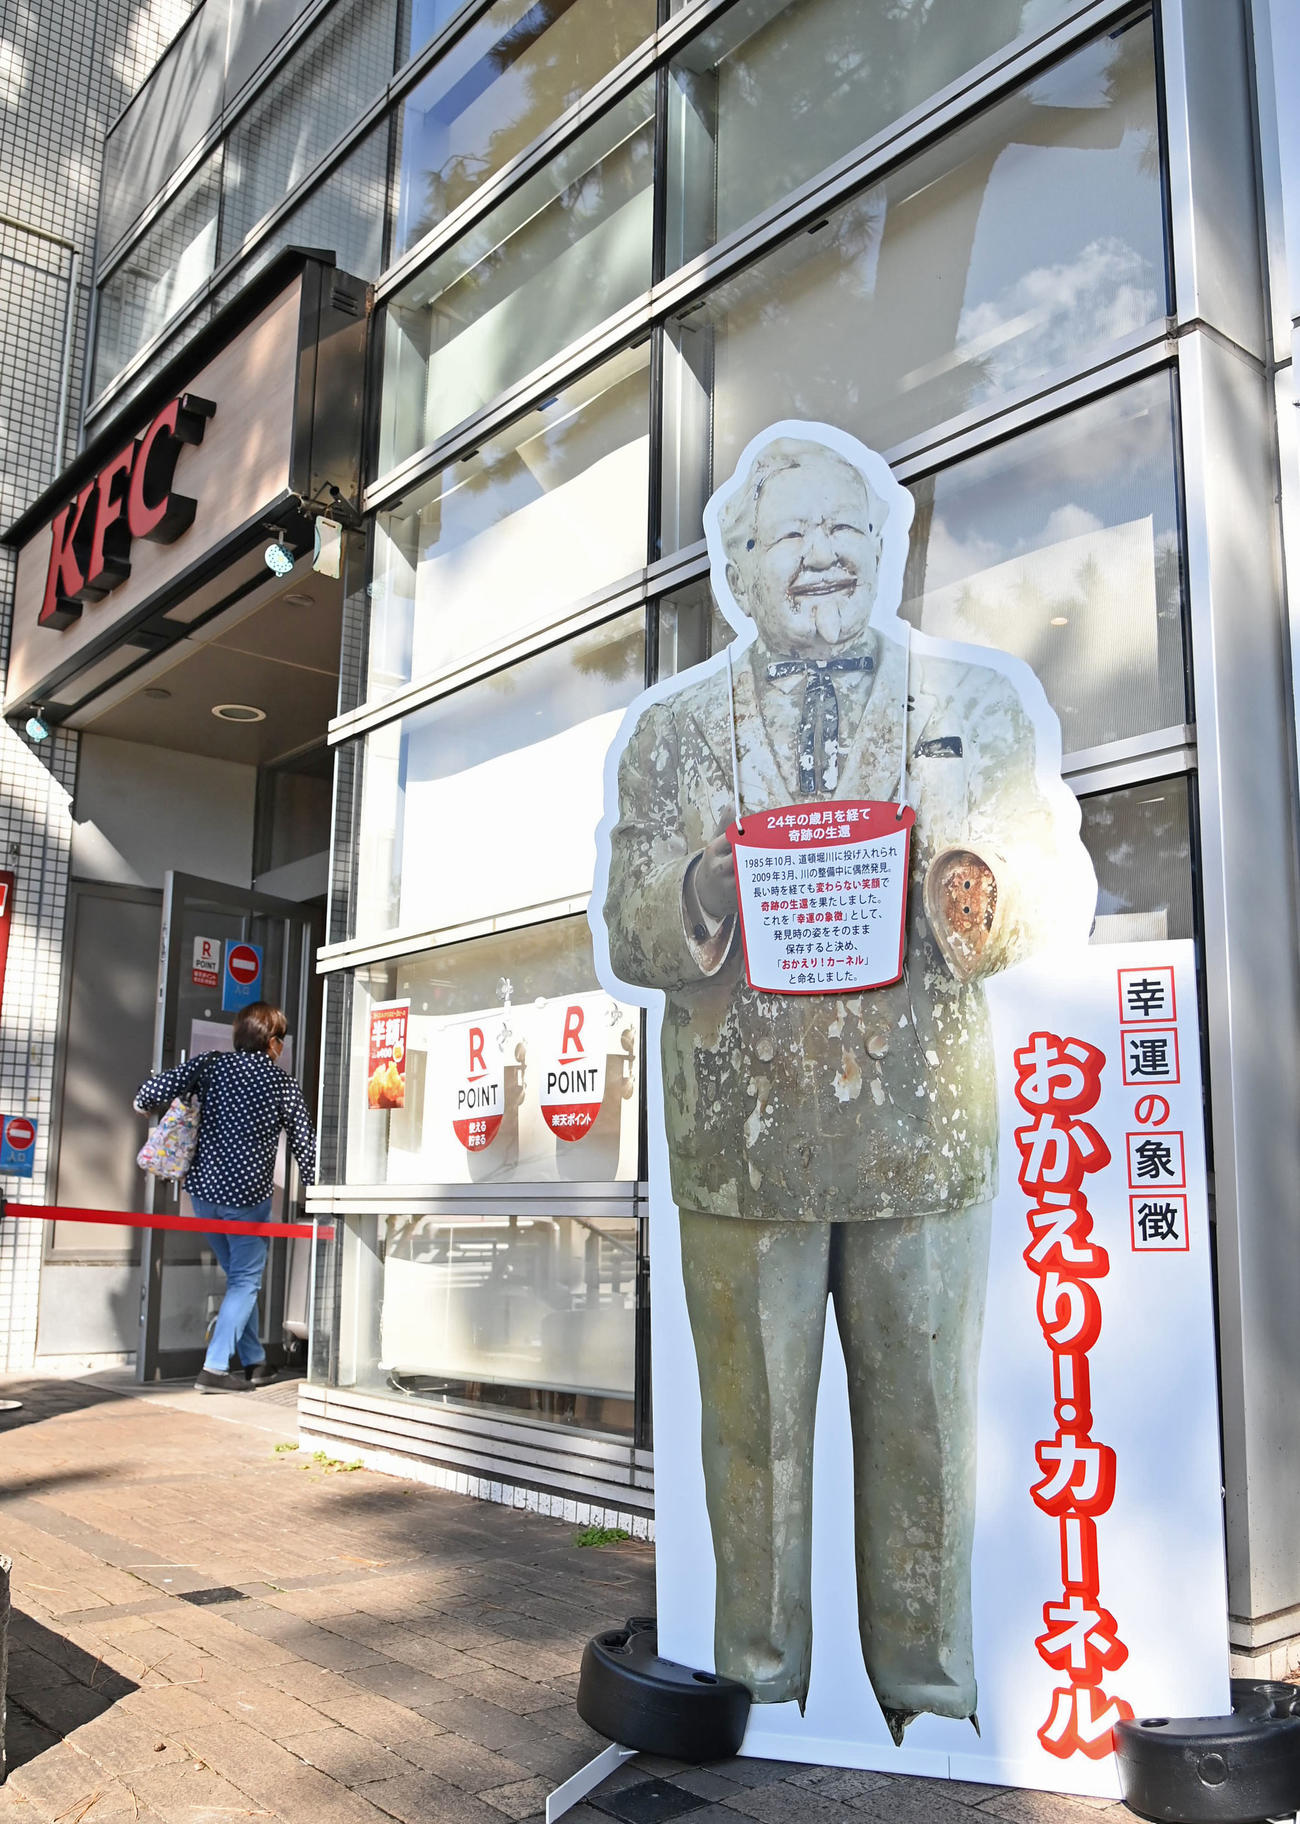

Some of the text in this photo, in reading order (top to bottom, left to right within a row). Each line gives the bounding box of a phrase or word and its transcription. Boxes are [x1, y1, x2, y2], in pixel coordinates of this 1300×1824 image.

[37, 395, 194, 629] KFC
[766, 808, 871, 829] 24年の歳月を経て
[788, 825, 851, 842] 奇跡の生還
[744, 846, 898, 869] 1985年10月、道頓堀川に投げ入れられ
[751, 862, 892, 883] 2009年3月、川の整備中に偶然発見。
[753, 877, 889, 898] 長い時を経ても変わらない笑顔で
[760, 894, 882, 912] 奇跡の生還を果たしました。
[763, 909, 883, 926] これを「幸運の象徴」として、
[773, 924, 870, 941] 発見時の姿をそのまま
[202, 941, 211, 957] R
[785, 940, 858, 955] 保存すると決め、
[195, 960, 216, 971] POINT
[777, 955, 870, 971] 「おかえり！カーネル」
[788, 970, 858, 985] と命名しました。
[561, 1005, 585, 1054] R
[469, 1027, 487, 1072] R
[547, 1069, 598, 1095] POINT
[458, 1084, 498, 1110] POINT
[1126, 978, 1179, 1242] 幸運の象徴
[468, 1121, 487, 1133] 使える
[551, 1112, 592, 1127] 楽天ポイント
[468, 1134, 487, 1147] 貯まる
[1017, 1035, 1128, 1752] おかえり！カーネル
